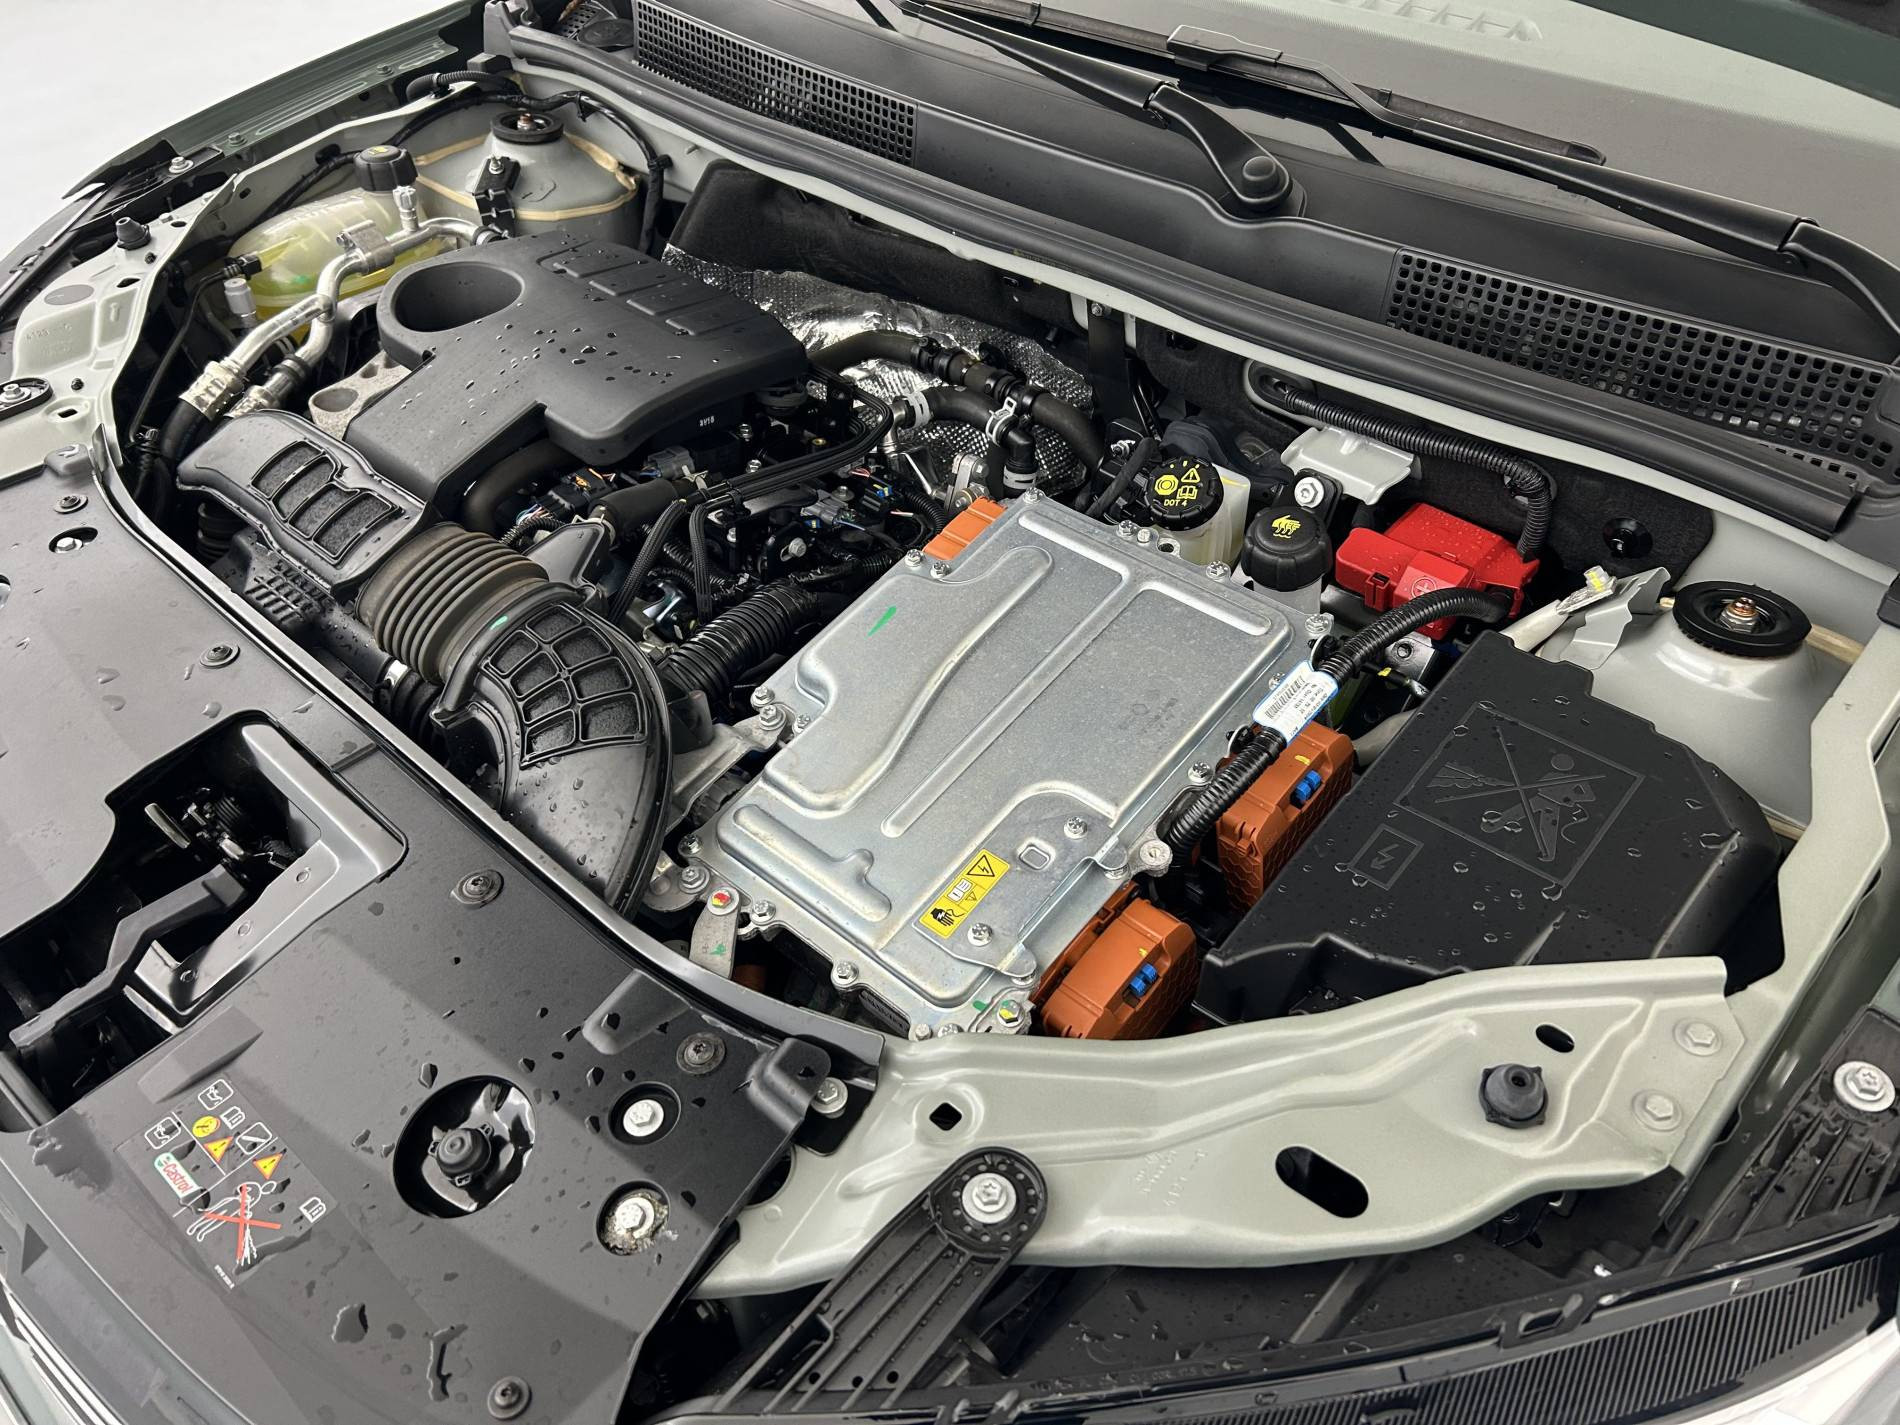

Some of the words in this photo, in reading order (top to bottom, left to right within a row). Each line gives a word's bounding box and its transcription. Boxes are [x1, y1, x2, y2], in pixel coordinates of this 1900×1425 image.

[1163, 499, 1181, 507] DOT
[1181, 499, 1188, 507] 4
[163, 1163, 194, 1194] Castrol
